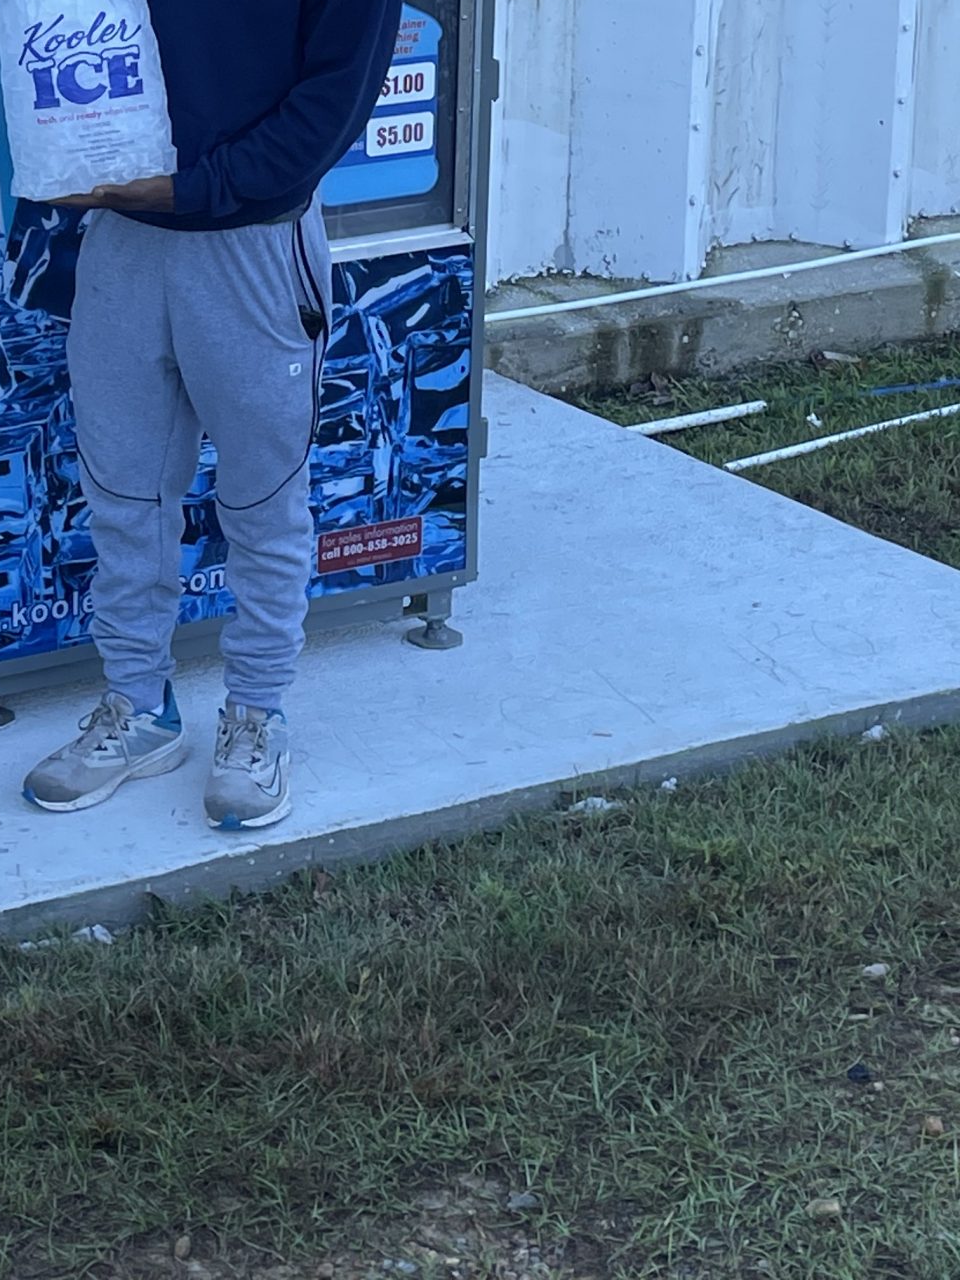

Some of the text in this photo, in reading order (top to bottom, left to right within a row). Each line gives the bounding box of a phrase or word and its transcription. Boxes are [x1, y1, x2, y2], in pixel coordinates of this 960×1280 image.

[18, 11, 141, 66] Kooler
[26, 44, 144, 111] ICE
[381, 73, 424, 97] $1.00
[376, 122, 424, 148] $5.00
[321, 546, 340, 560] call
[343, 532, 418, 556] 800-858-3025
[322, 523, 418, 547] for sales information
